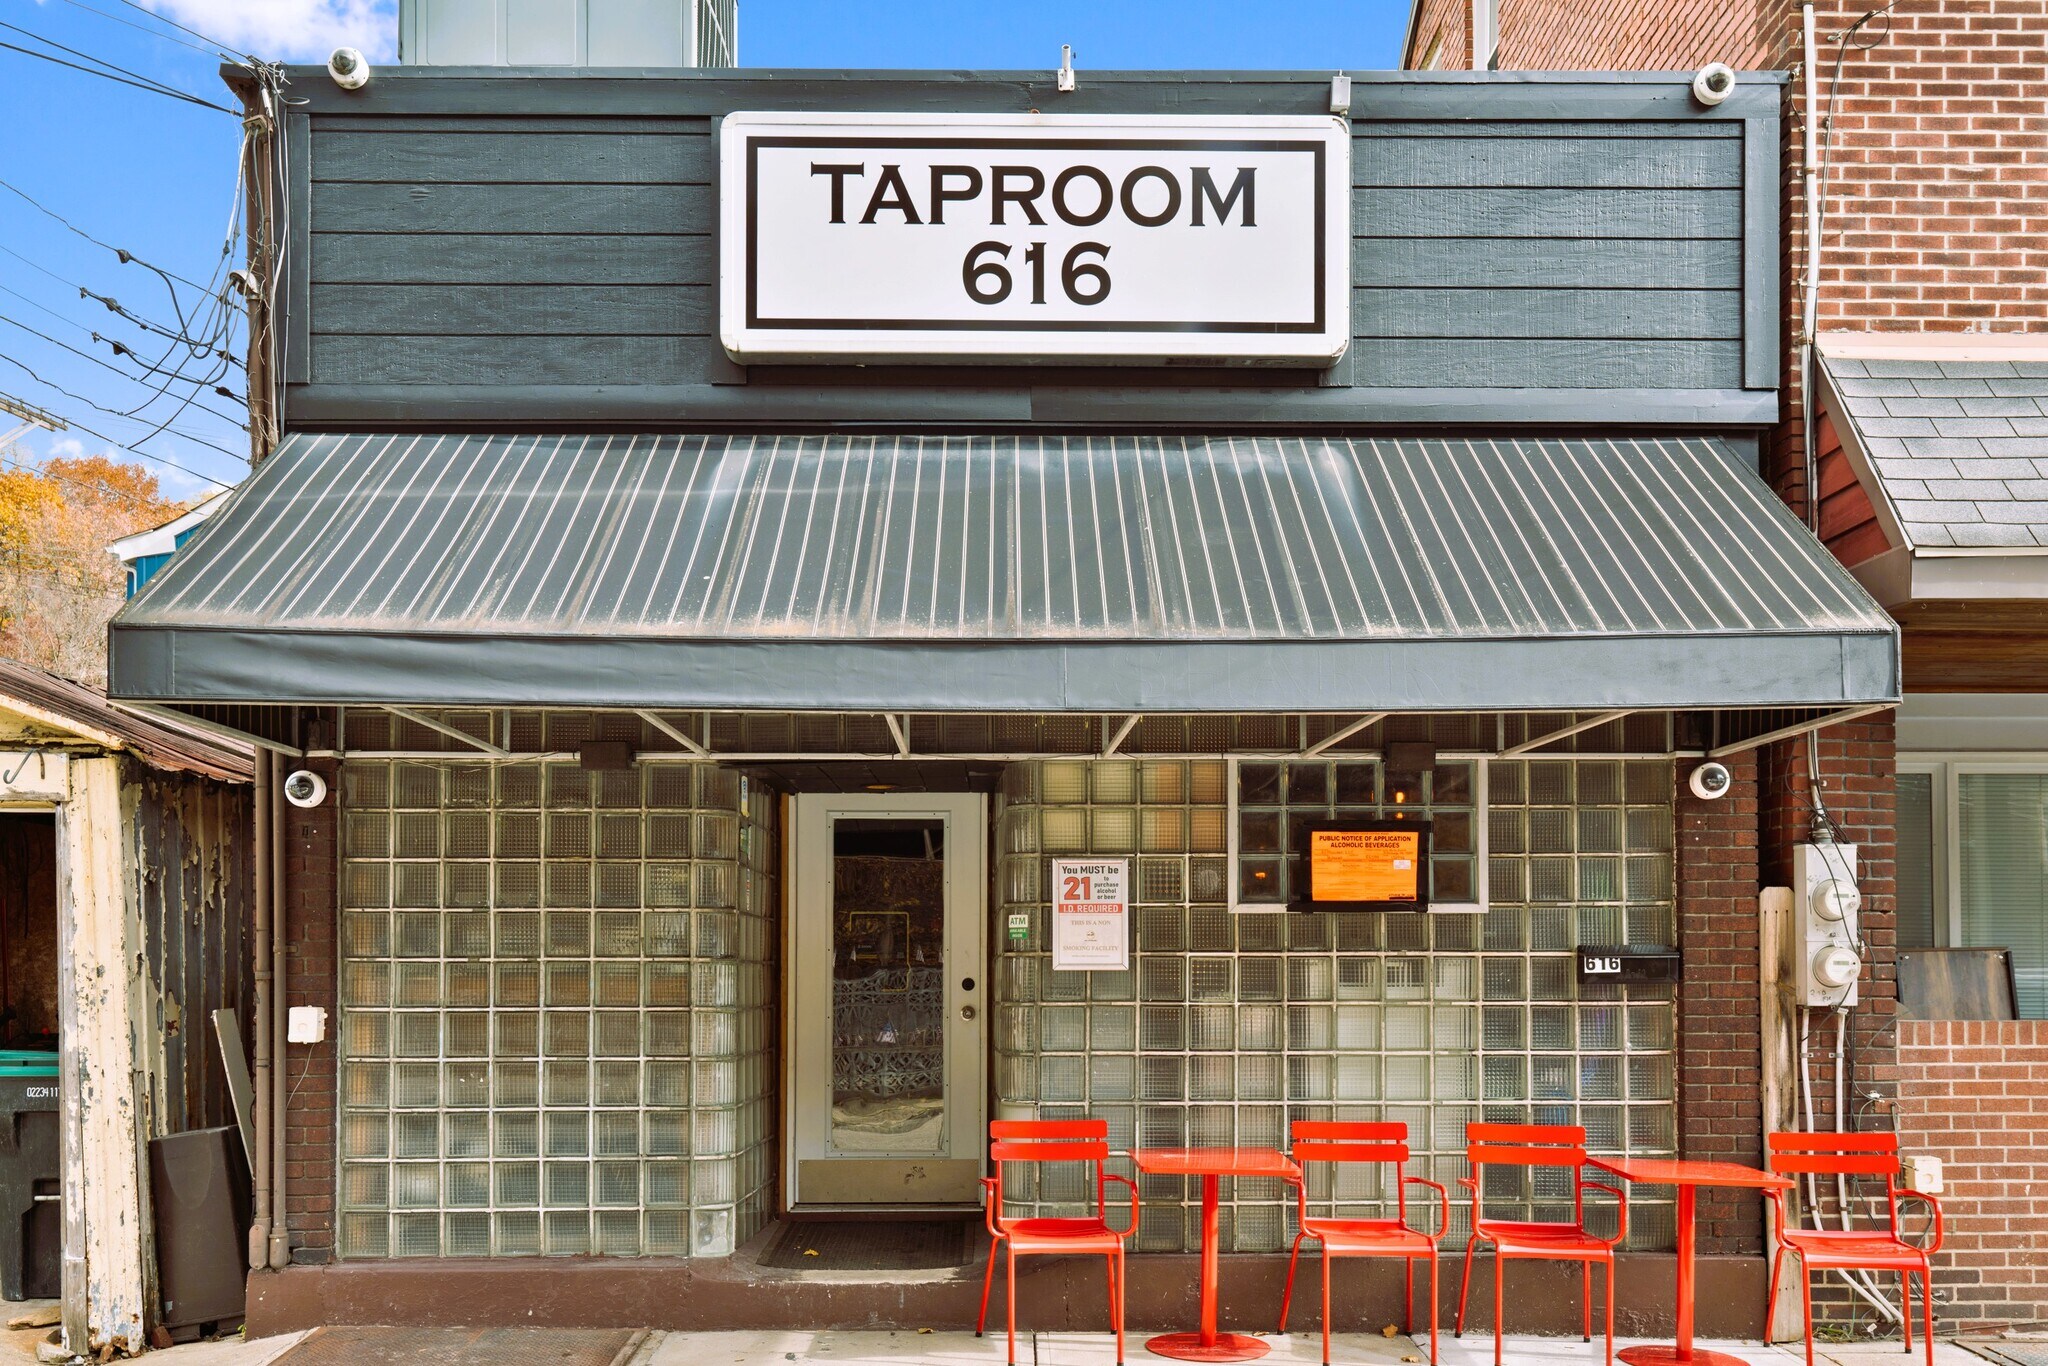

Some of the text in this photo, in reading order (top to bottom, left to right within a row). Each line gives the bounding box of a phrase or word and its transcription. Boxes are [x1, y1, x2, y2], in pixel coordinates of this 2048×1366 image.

[810, 161, 1257, 228] TAPROOM
[962, 240, 1112, 306] 616
[1062, 865, 1119, 874] You MUST be
[1064, 876, 1090, 900] 21
[1063, 904, 1119, 913] I.D. REQUIRED
[1010, 917, 1026, 925] ATM
[1586, 957, 1619, 970] 616
